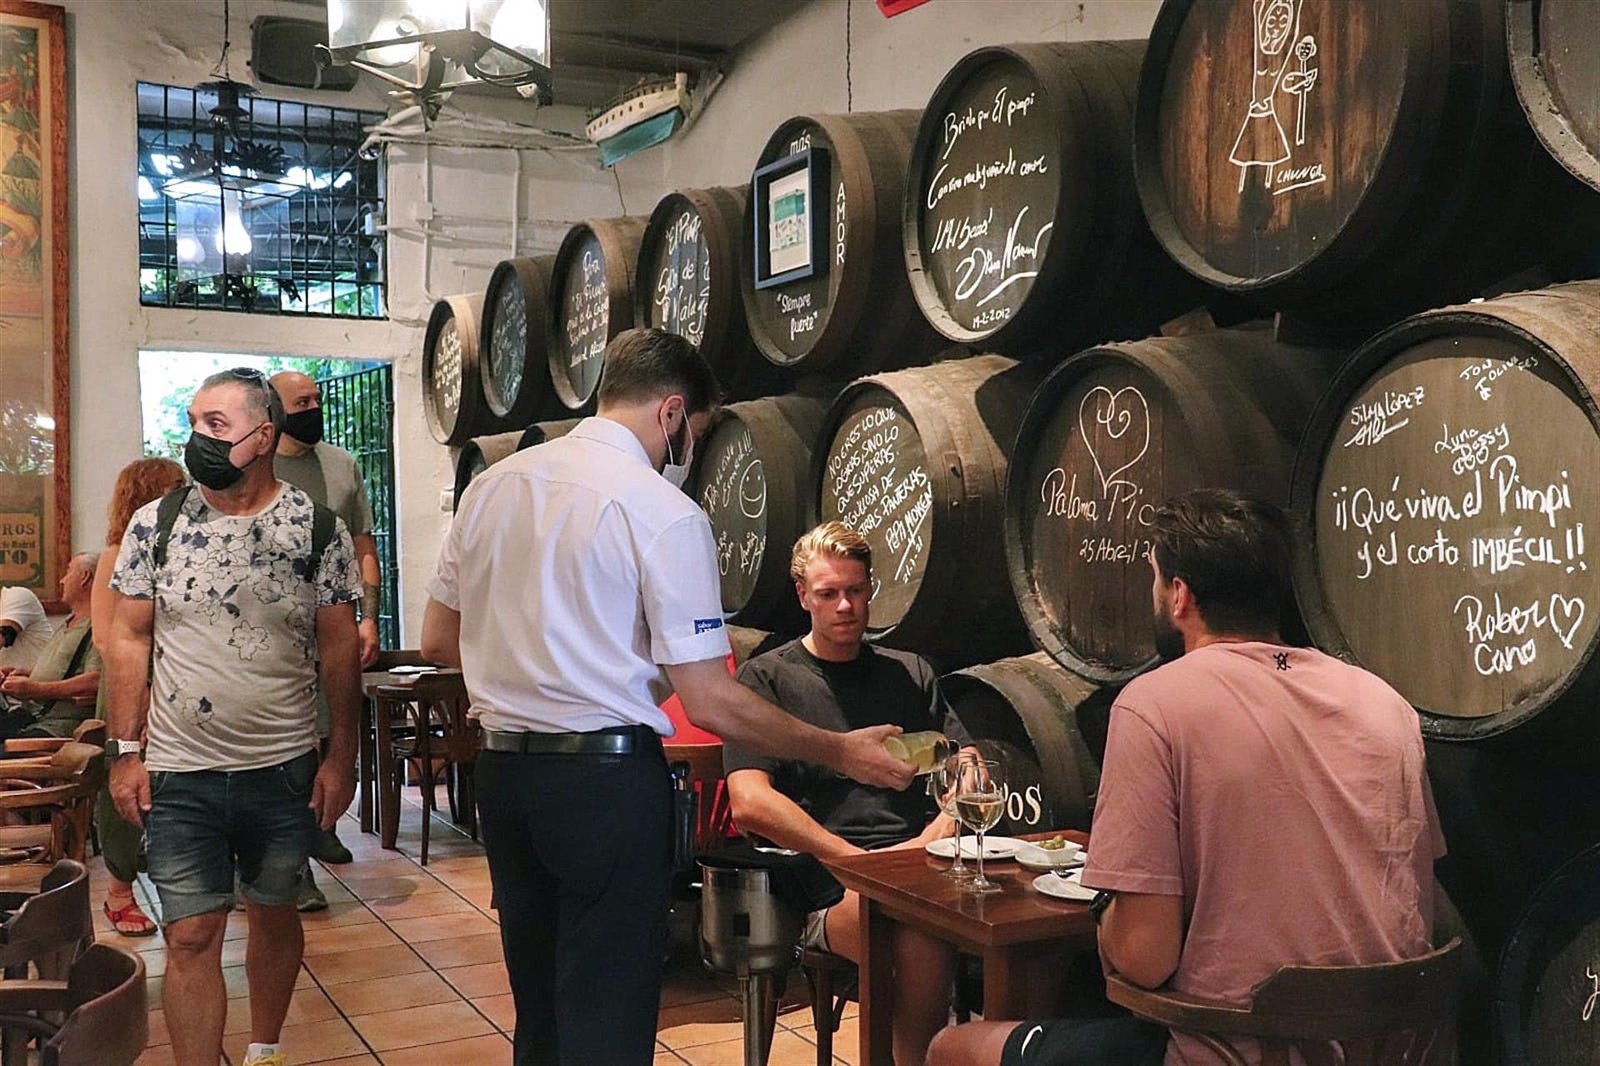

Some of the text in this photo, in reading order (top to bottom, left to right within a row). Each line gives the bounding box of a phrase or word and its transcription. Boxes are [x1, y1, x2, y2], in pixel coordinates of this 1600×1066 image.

[790, 129, 811, 155] más
[836, 182, 846, 265] AMOR
[1459, 358, 1492, 381] JON
[828, 407, 896, 479] NO ERES LO QUE
[884, 426, 899, 443] LO
[881, 467, 896, 494] DE
[1405, 488, 1460, 522] viva
[1463, 470, 1482, 518] el
[1489, 454, 1571, 528] Pimpi
[838, 484, 855, 513] QUE
[1041, 467, 1157, 526] Paloma Pic
[2, 523, 35, 536] ROS
[1080, 538, 1094, 563] 25
[1356, 541, 1372, 579] y
[1376, 531, 1398, 565] el
[1407, 529, 1459, 566] corto
[1475, 638, 1536, 676] Cano
